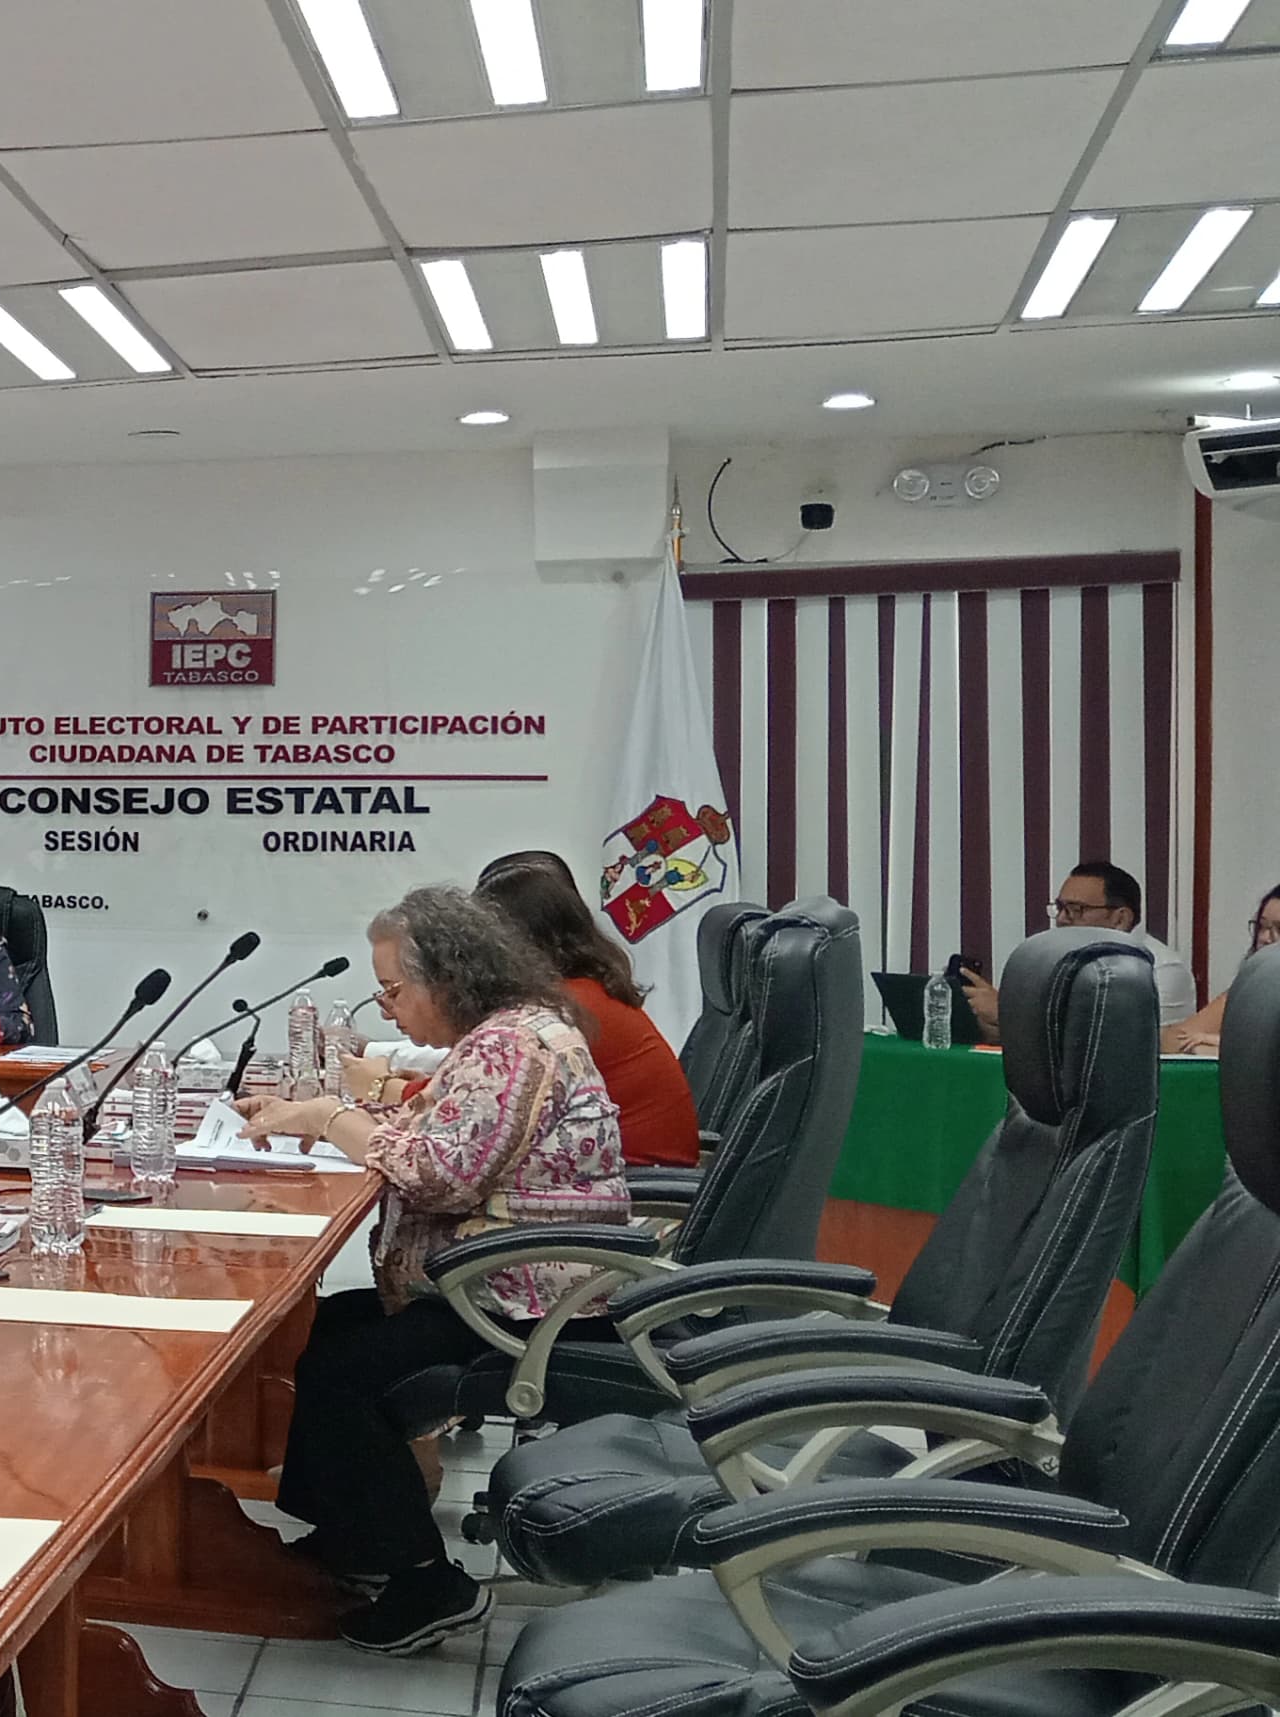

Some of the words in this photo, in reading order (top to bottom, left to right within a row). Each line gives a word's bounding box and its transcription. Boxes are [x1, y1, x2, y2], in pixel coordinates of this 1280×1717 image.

[172, 643, 252, 669] IEPC
[163, 671, 259, 683] TABASCO
[54, 716, 223, 735] ELECTORAL
[232, 716, 252, 735] Y
[262, 716, 300, 735] DE
[312, 711, 545, 735] PARTICIPACIÓN
[30, 745, 196, 764] CIUDADANA
[207, 745, 244, 763] DE
[253, 744, 395, 764] TABASCO
[227, 786, 430, 814] ESTATAL
[44, 826, 139, 852] SESIÓN
[263, 831, 416, 852] ORDINARIA
